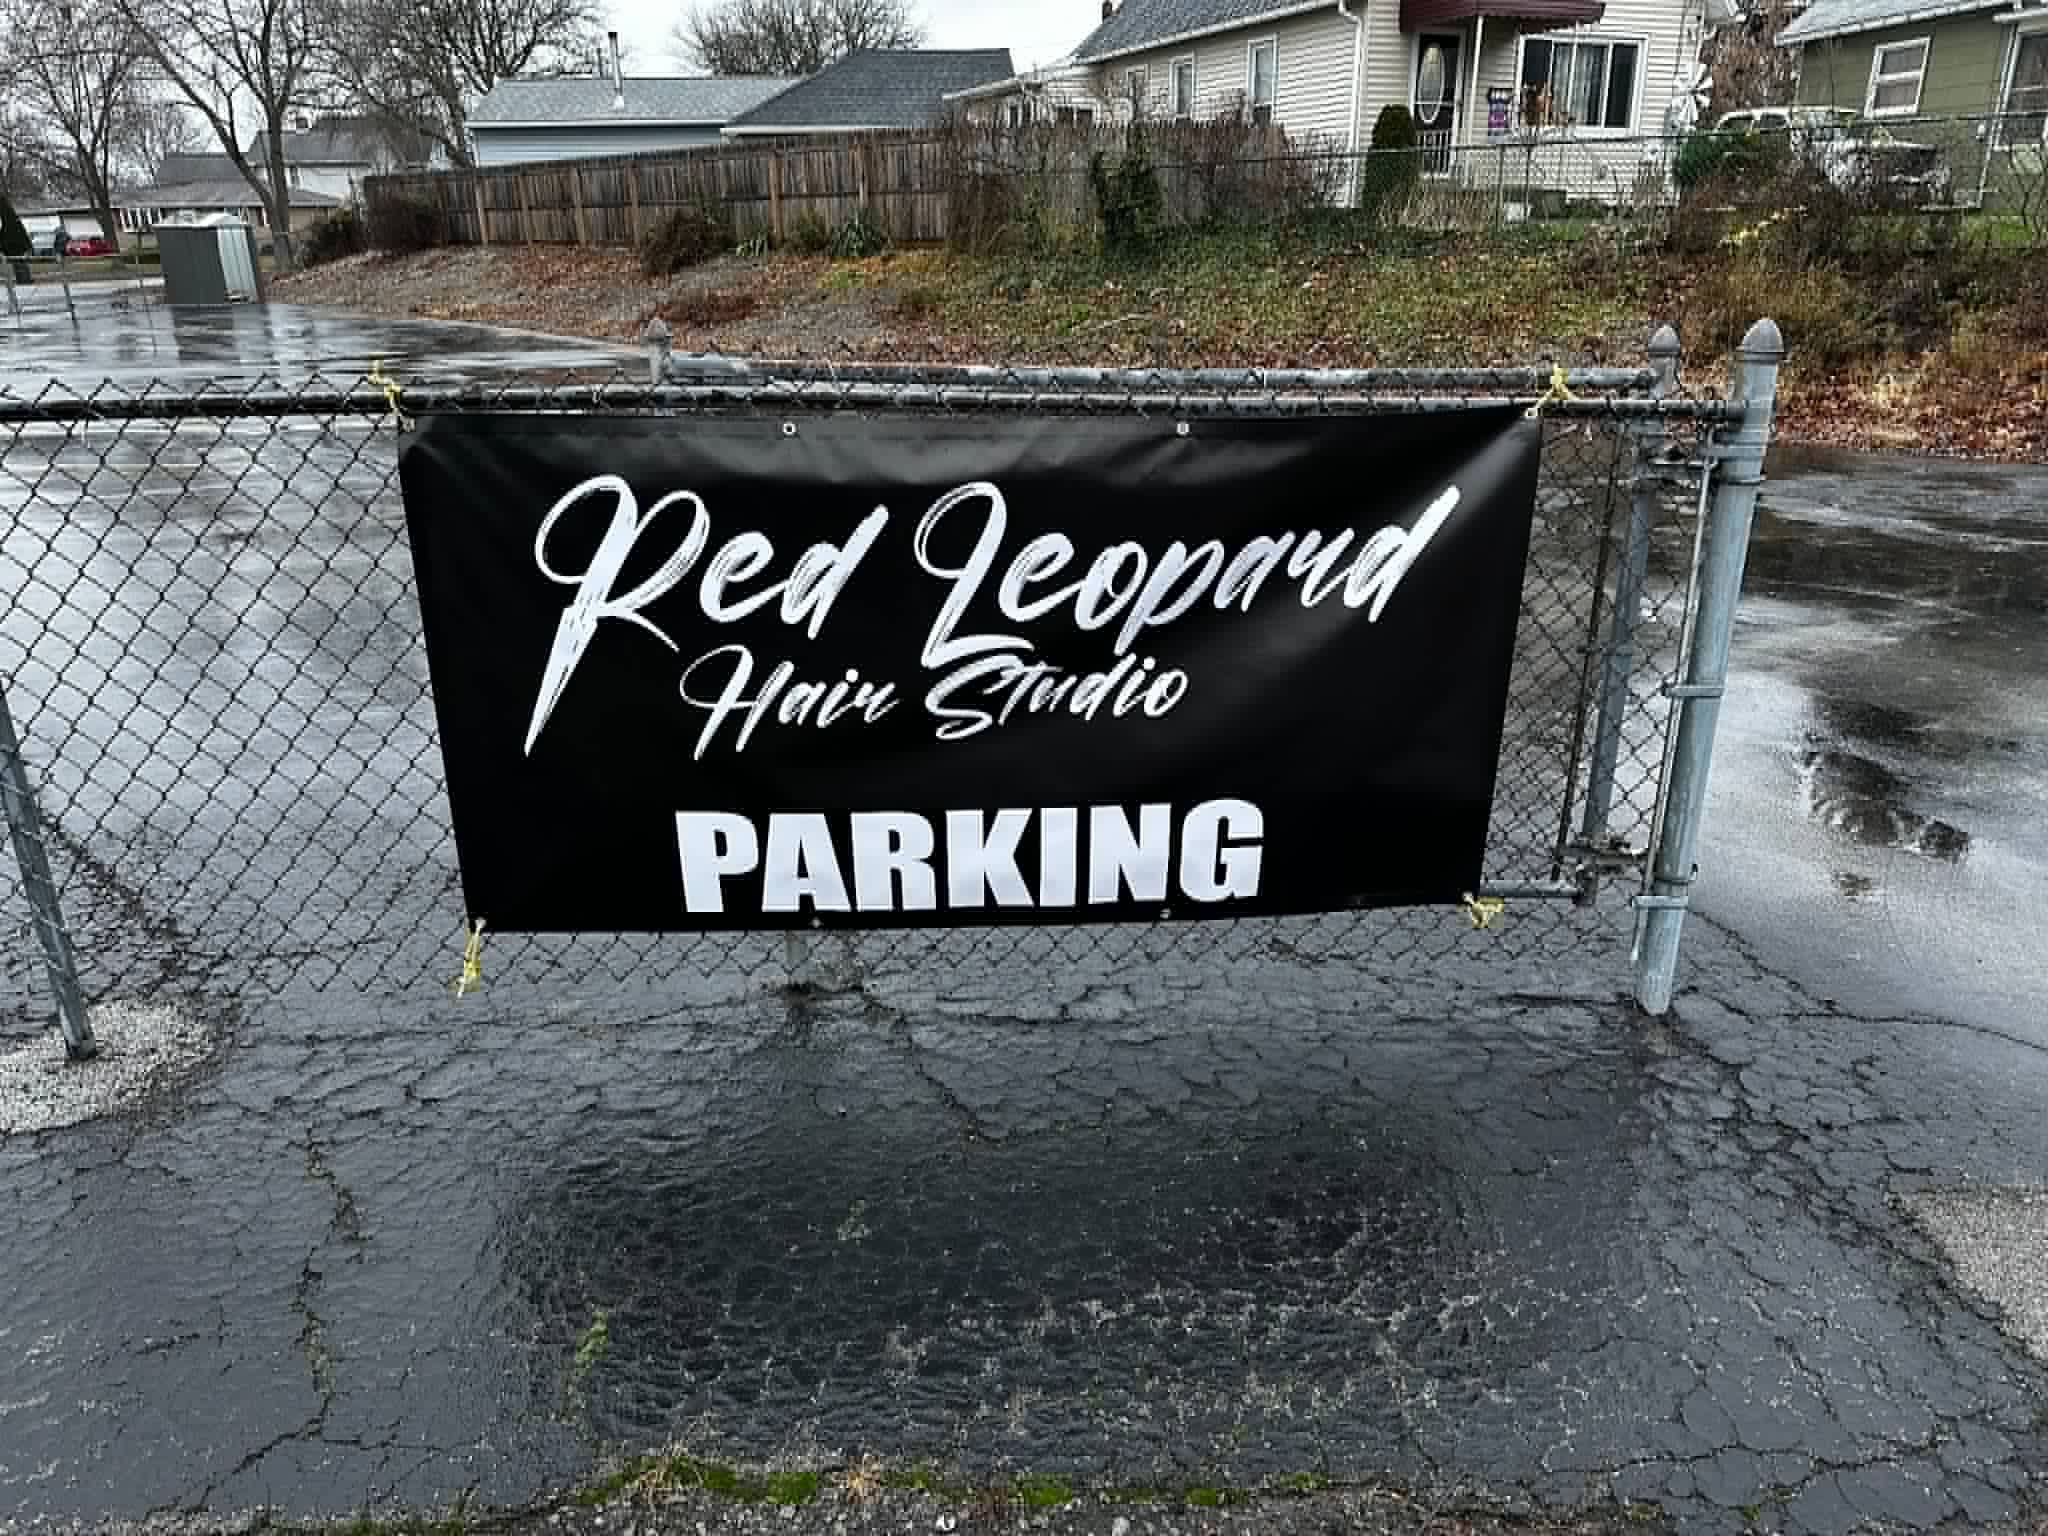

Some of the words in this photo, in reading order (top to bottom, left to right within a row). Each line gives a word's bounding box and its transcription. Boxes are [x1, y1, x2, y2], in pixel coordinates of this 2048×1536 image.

[524, 474, 889, 758] Red
[913, 481, 1461, 670] Leopard
[679, 644, 898, 761] Hair
[924, 652, 1190, 741] Studio
[675, 799, 1265, 913] PARKING
